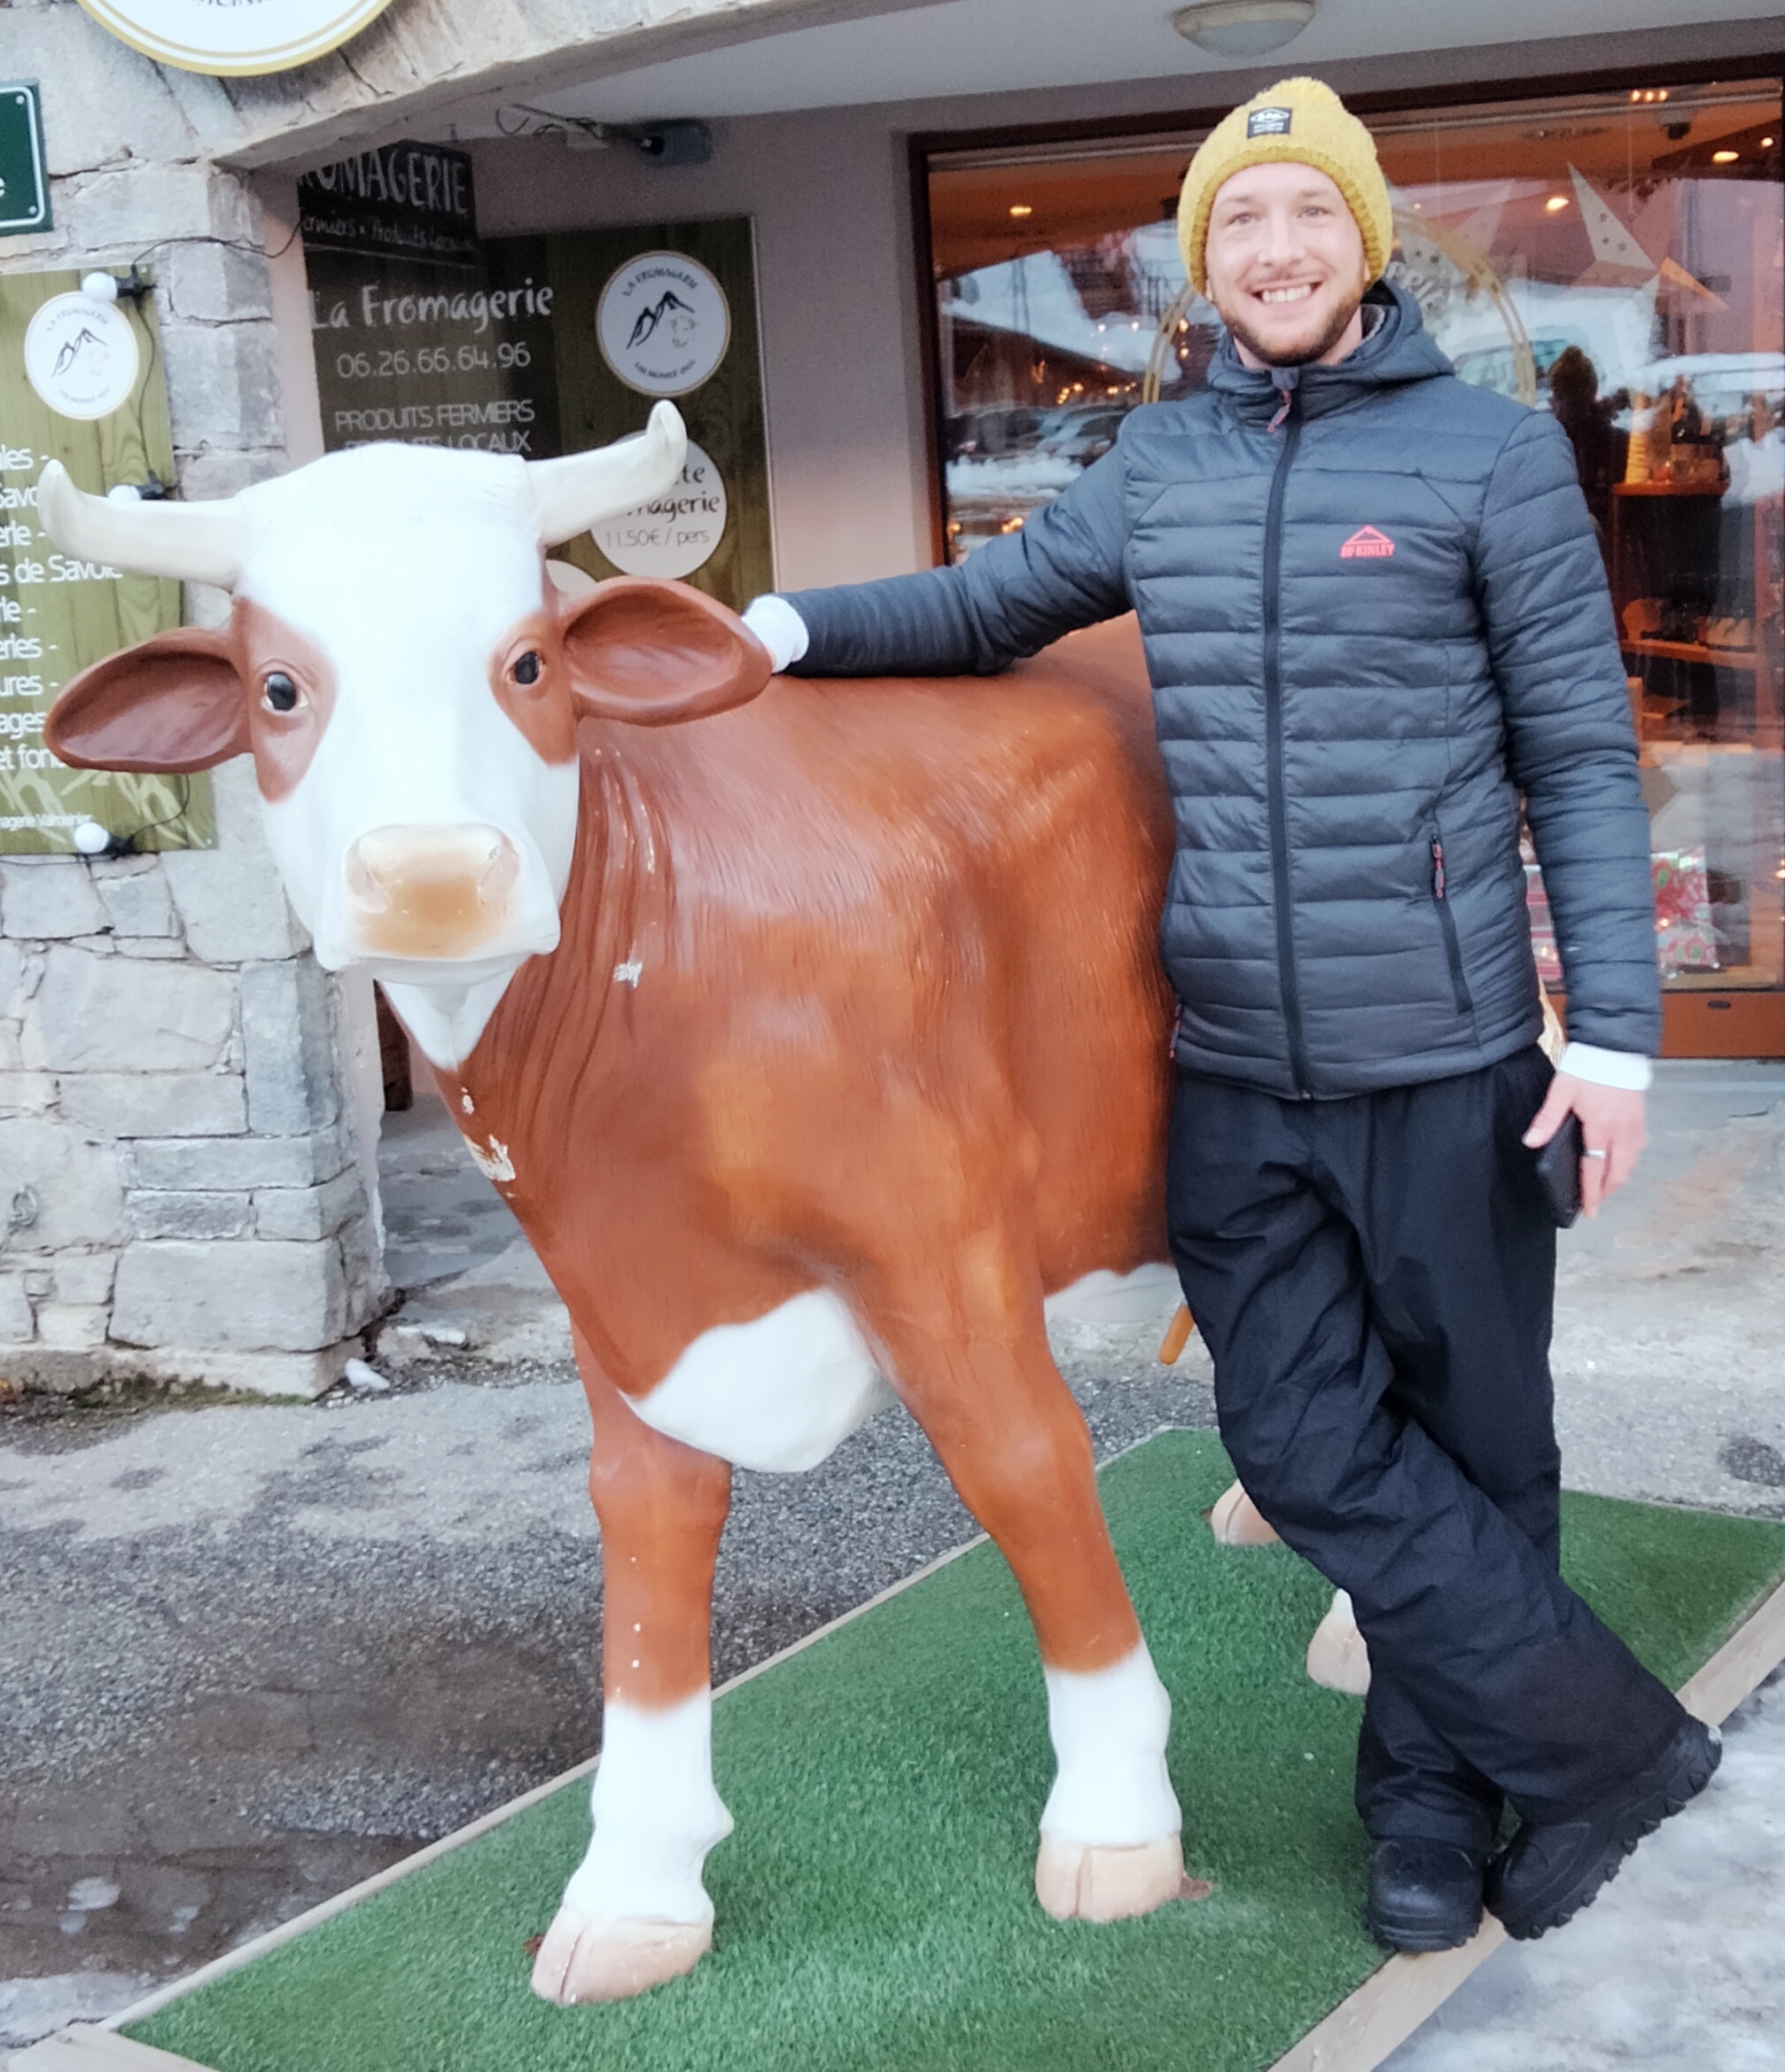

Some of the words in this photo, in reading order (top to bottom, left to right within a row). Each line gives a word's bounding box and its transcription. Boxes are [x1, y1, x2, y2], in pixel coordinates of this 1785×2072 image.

[309, 289, 350, 329] La
[362, 277, 554, 334] Fromagerie
[337, 341, 531, 378] 06.26.66.64.96
[334, 406, 433, 432] PRODUITS
[437, 400, 535, 426] FERMIERS
[0, 443, 34, 470] les
[0, 483, 38, 509] avo
[627, 490, 721, 524] agerie
[676, 529, 710, 548] pers
[14, 557, 45, 583] de
